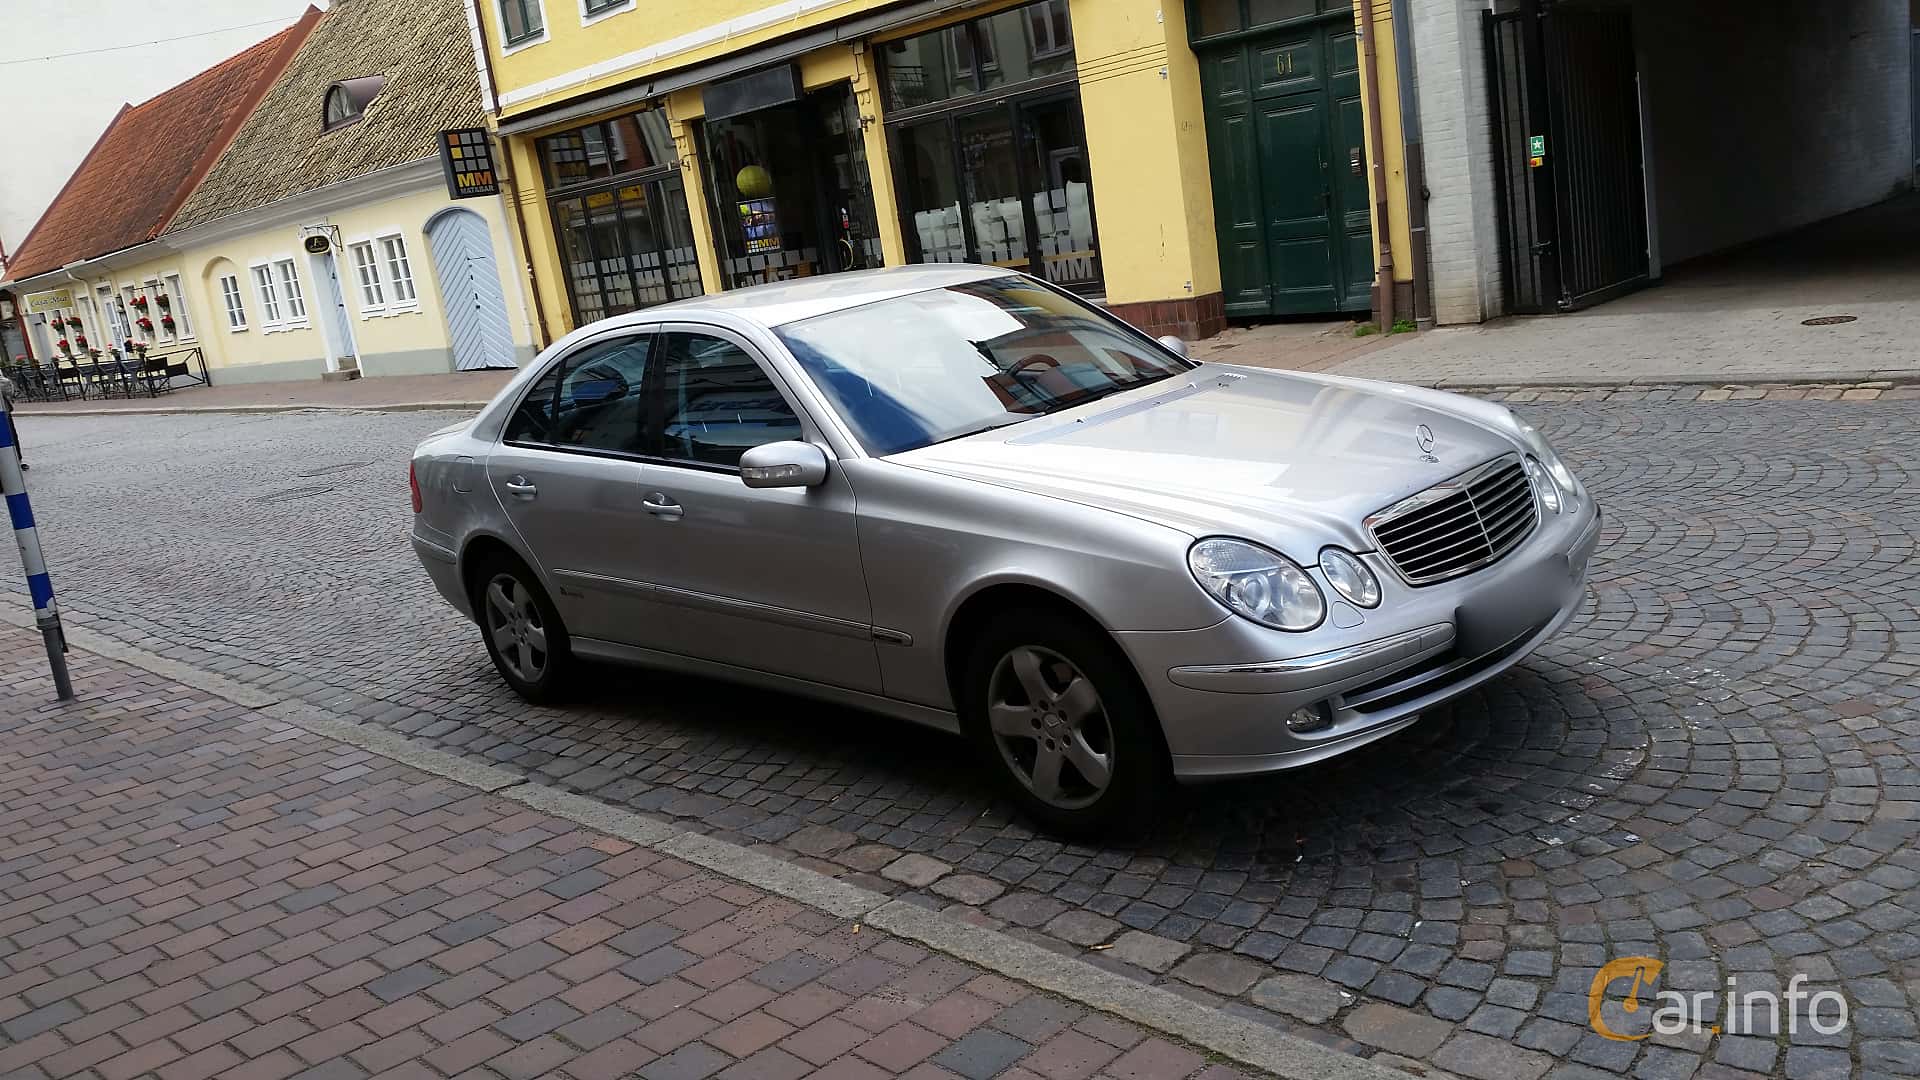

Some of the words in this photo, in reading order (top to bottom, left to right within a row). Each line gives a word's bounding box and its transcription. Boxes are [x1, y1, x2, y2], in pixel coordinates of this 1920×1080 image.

[1276, 52, 1293, 75] 61
[457, 171, 492, 187] MM
[1044, 256, 1093, 282] MM
